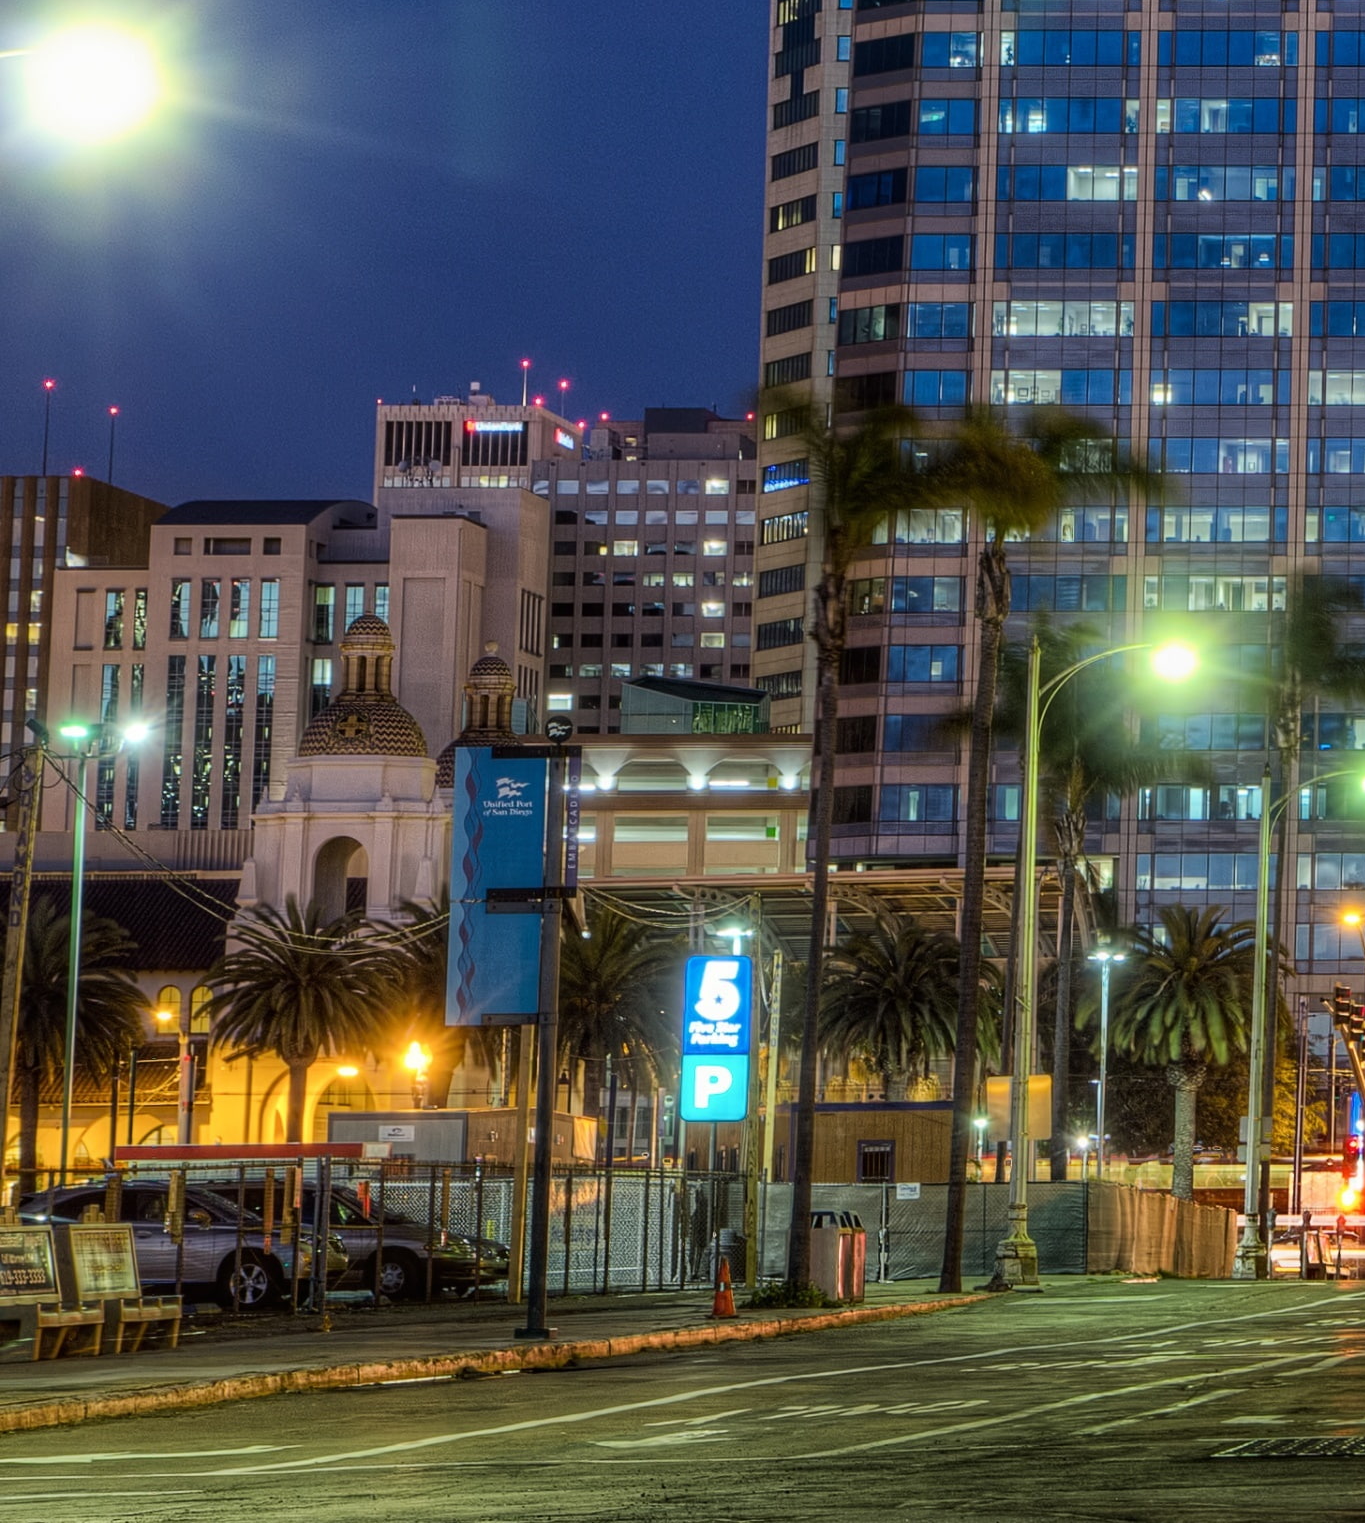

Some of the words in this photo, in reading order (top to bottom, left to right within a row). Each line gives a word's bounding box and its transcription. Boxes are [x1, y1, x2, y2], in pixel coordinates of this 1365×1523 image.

[483, 800, 514, 810] Unified
[516, 800, 533, 809] Port
[510, 809, 533, 818] Diego
[694, 961, 741, 1022] 5
[694, 1066, 733, 1109] P
[643, 1400, 990, 1427] ONLY
